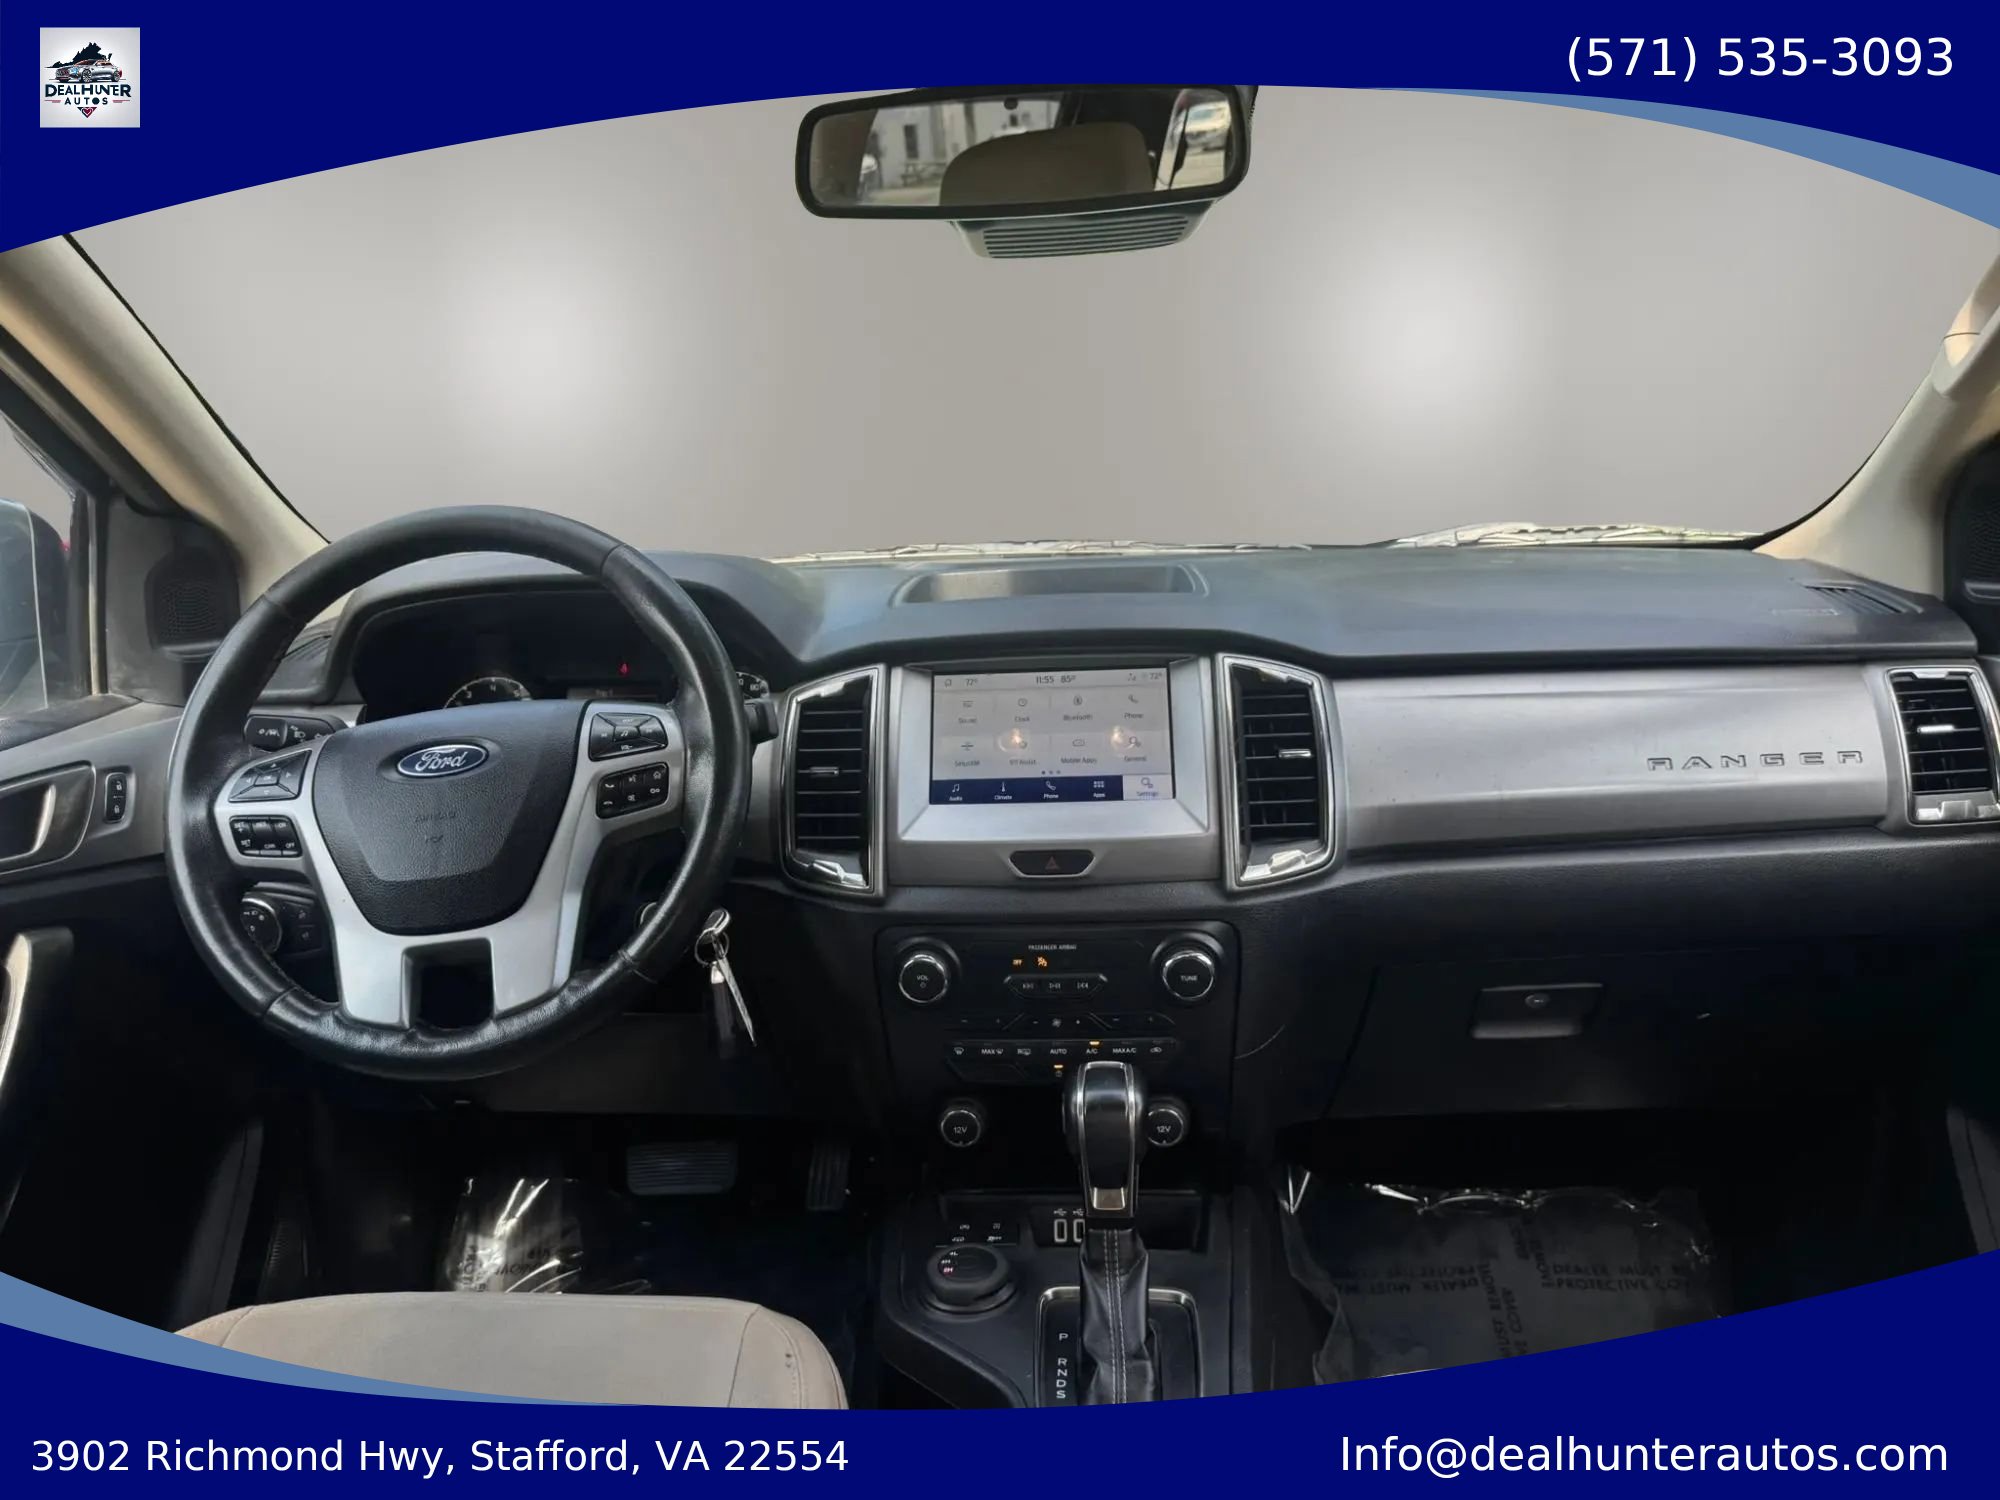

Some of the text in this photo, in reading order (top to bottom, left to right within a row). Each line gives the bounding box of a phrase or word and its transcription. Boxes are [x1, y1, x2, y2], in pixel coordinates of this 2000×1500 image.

[1036, 676, 1054, 684] 11:55
[415, 749, 467, 771] Ford
[1647, 750, 1863, 771] RANGER
[953, 1125, 968, 1135] 12V
[1156, 1124, 1172, 1134] 12V
[1059, 1333, 1068, 1341] P
[1057, 1358, 1068, 1366] R
[1057, 1369, 1068, 1377] N
[1056, 1379, 1066, 1388] D
[1056, 1390, 1067, 1399] S
